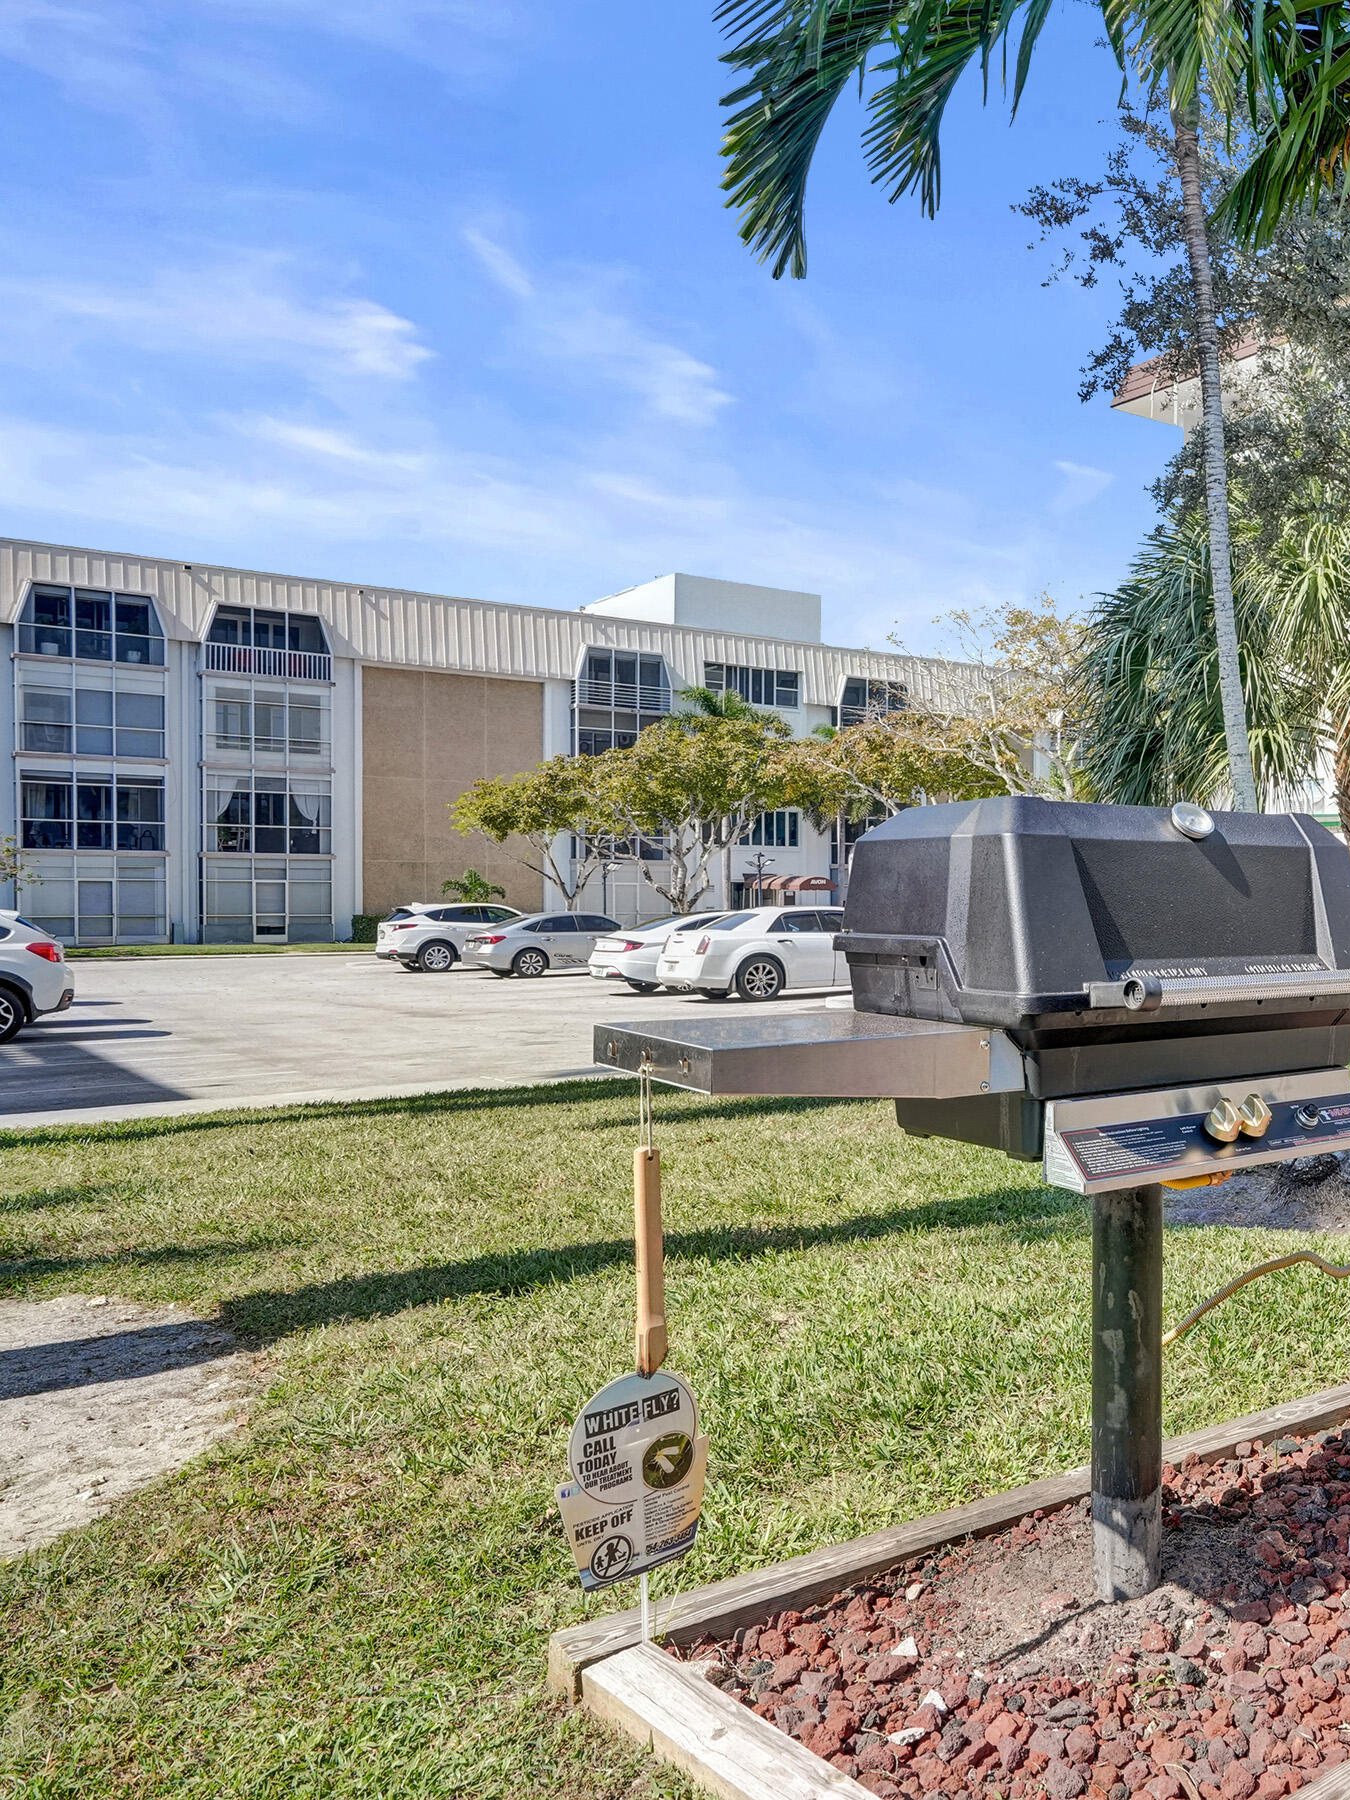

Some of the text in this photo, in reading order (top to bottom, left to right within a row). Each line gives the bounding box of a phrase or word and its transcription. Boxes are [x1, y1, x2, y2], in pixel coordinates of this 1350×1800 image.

[583, 1436, 617, 1459] CALL
[577, 1451, 617, 1475] TODAY
[582, 1461, 629, 1482] TO HEAR ABOUT
[584, 1466, 633, 1490] OUR TREATMENT
[599, 1474, 633, 1492] PROGRAMS
[574, 1519, 608, 1542] KEEP
[610, 1509, 634, 1528] OFF
